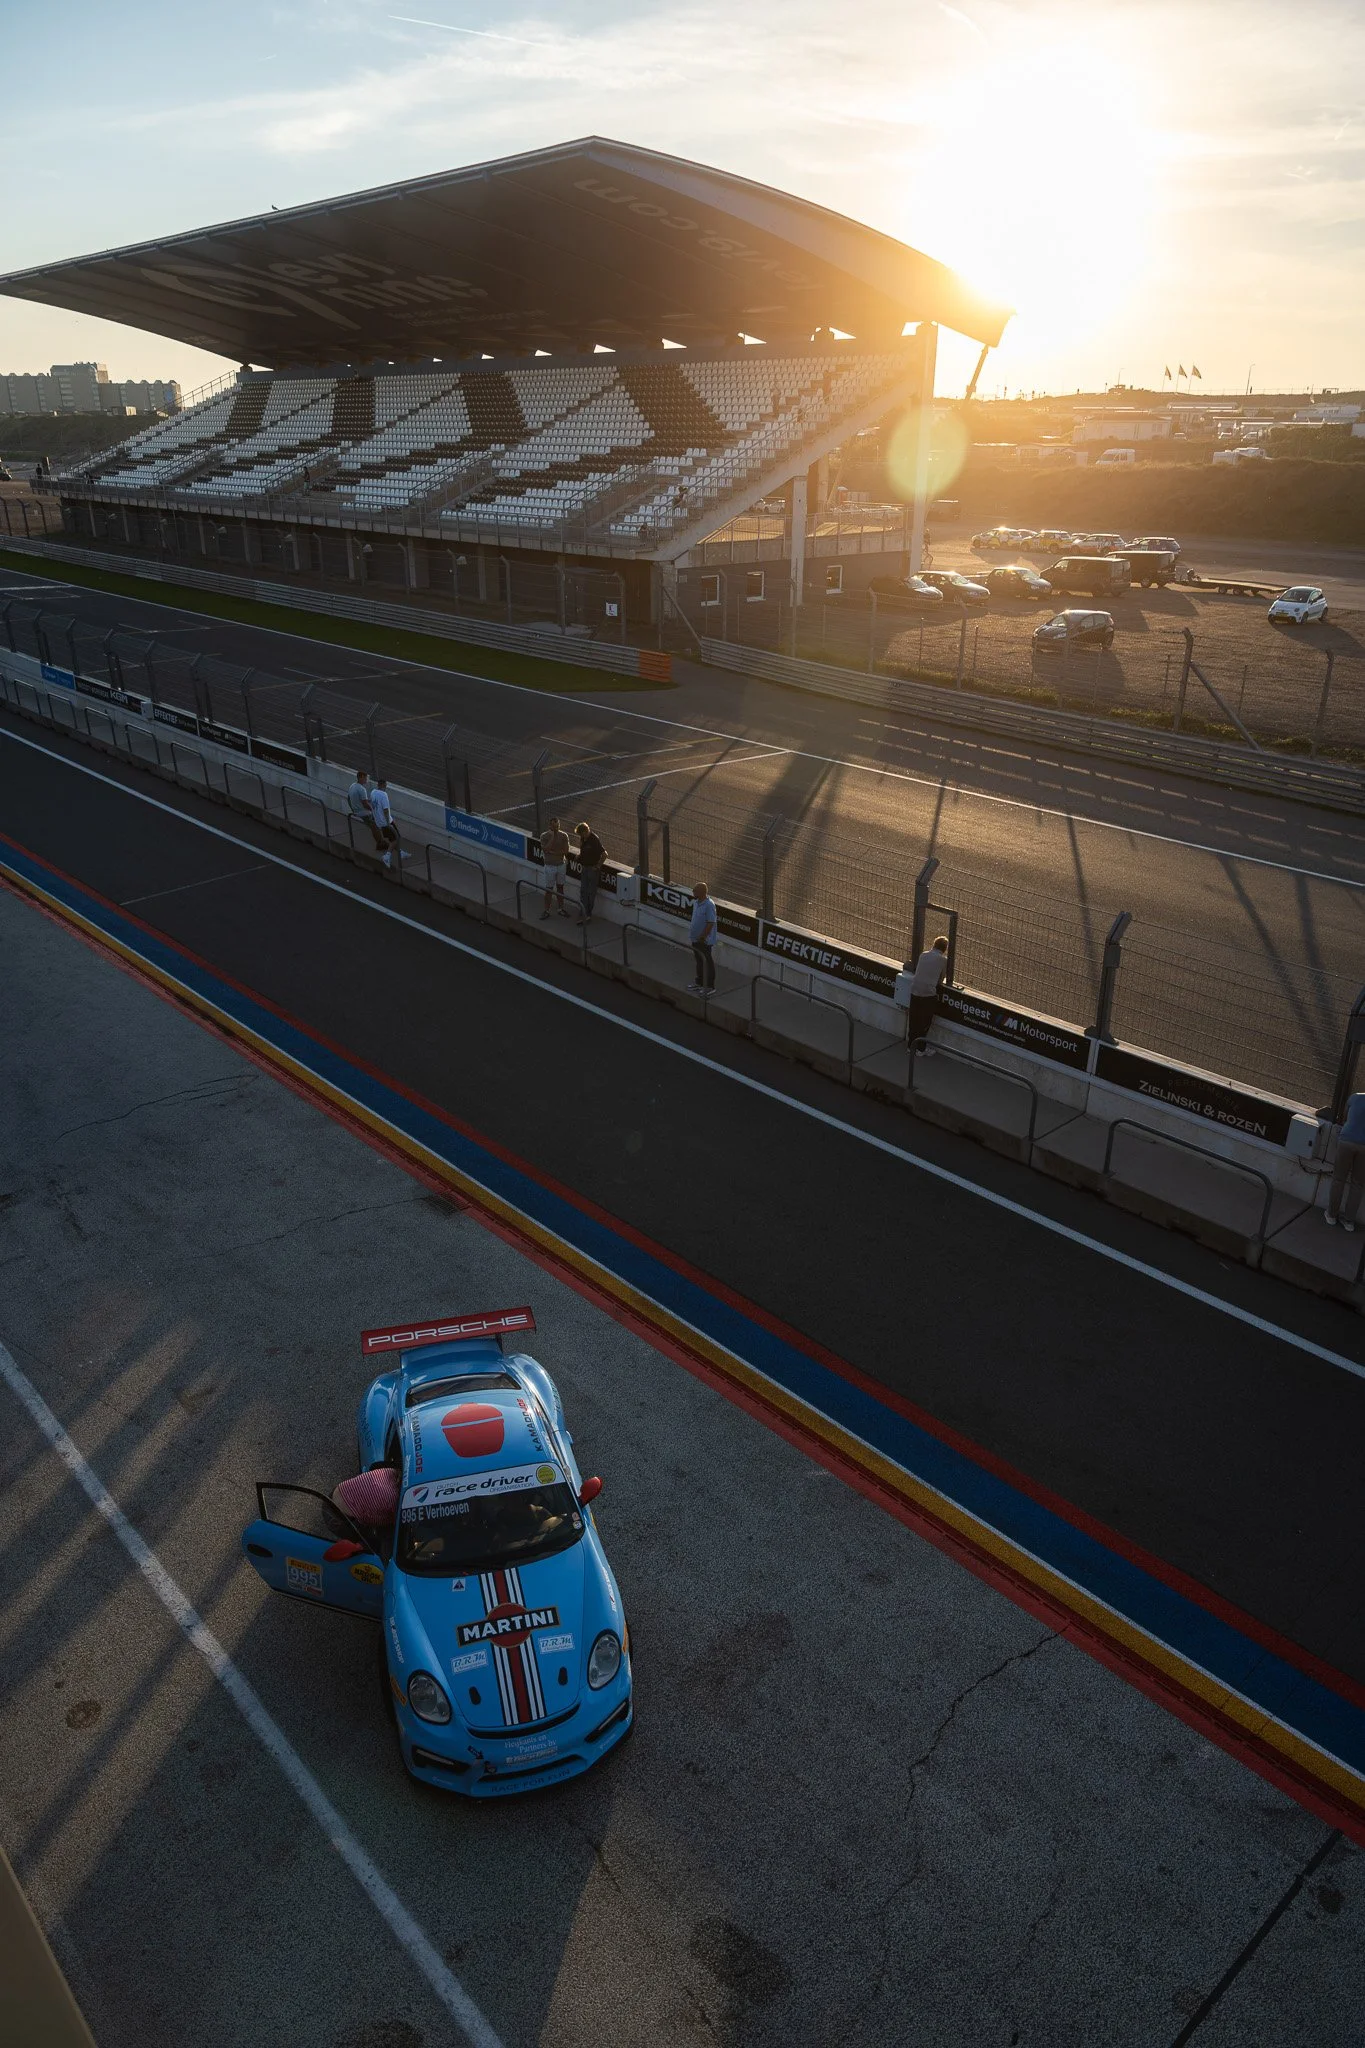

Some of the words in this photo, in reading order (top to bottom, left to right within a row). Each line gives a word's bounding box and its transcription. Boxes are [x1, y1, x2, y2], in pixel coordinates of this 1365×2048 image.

[109, 690, 129, 704] KGM
[456, 820, 481, 837] finder
[647, 883, 696, 910] KGM
[766, 931, 841, 969] EFFEKTIEF
[843, 962, 869, 982] facility
[941, 993, 991, 1020] Poelgeest
[1020, 1022, 1078, 1053] Motorsport
[1138, 1079, 1202, 1112] ZIELINSKI
[1203, 1104, 1215, 1117] &
[1217, 1111, 1267, 1137] ROZEN
[368, 1313, 529, 1347] PORSCHE
[434, 1481, 478, 1498] race
[480, 1473, 534, 1489] driver
[436, 1481, 459, 1490] DUTCH
[401, 1509, 417, 1524] 995
[418, 1507, 424, 1521] E
[425, 1502, 470, 1520] Verhoeven
[290, 1567, 318, 1587] 995
[463, 1609, 555, 1642] MARTINI
[491, 1783, 522, 1793] RACE
[523, 1778, 545, 1788] FOR
